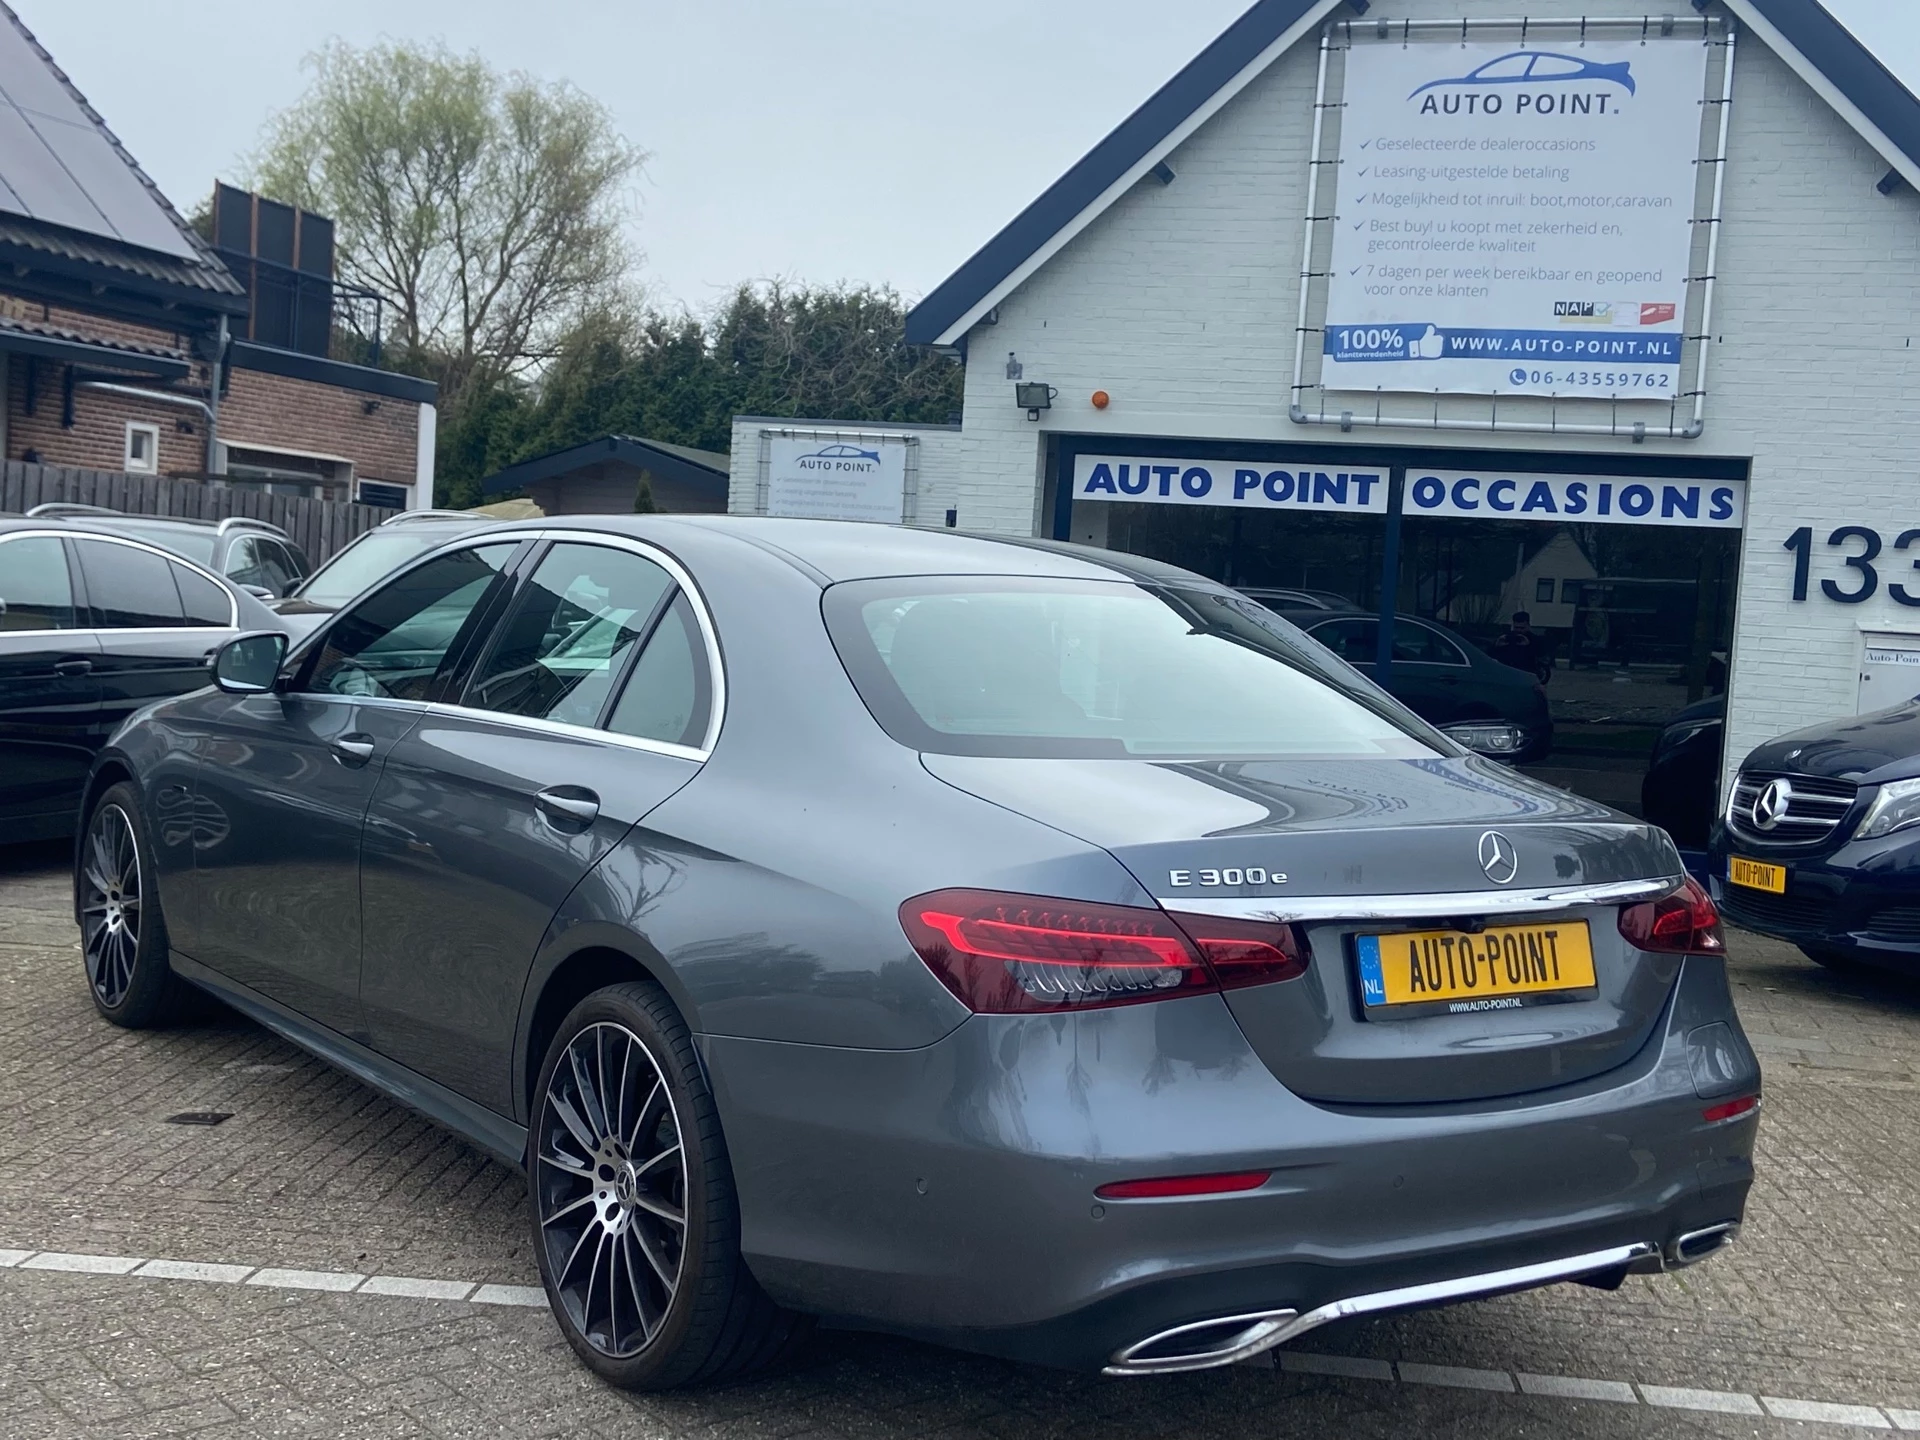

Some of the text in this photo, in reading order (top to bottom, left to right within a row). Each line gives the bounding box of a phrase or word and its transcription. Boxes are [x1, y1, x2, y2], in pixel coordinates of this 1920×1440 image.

[1420, 94, 1501, 114] AUTO
[1375, 137, 1596, 151] Geselecteerde dealeroccasions
[1373, 165, 1570, 182] Leasing-uitgestelde betaling
[1372, 192, 1672, 208] Mogelijkheid tot inruil: boot,motor,caravan
[1370, 220, 1623, 236] Best buy! u koopt met zekerheid en,
[1367, 238, 1536, 253] gecontroleerde kwaliteit
[1366, 264, 1662, 284] 7 dagen per week bereikbaar en geopend
[1364, 284, 1489, 296] voor onze klanten
[1554, 302, 1594, 316] NAP
[1338, 329, 1404, 349] 100%
[1451, 336, 1672, 356] WWW.AUTO-POINT.NL
[1530, 370, 1669, 387] 06-43559762
[800, 460, 831, 470] AUTO
[1084, 463, 1380, 505] AUTO POINT
[1412, 476, 1734, 521] OCCASIONS
[1169, 869, 1192, 887] E
[1735, 860, 1775, 888] AUTO-POINT
[1410, 931, 1560, 993] AUTO-POINT
[1364, 979, 1383, 995] NL
[1449, 997, 1523, 1013] WWW.AUTO-POINT.NL
